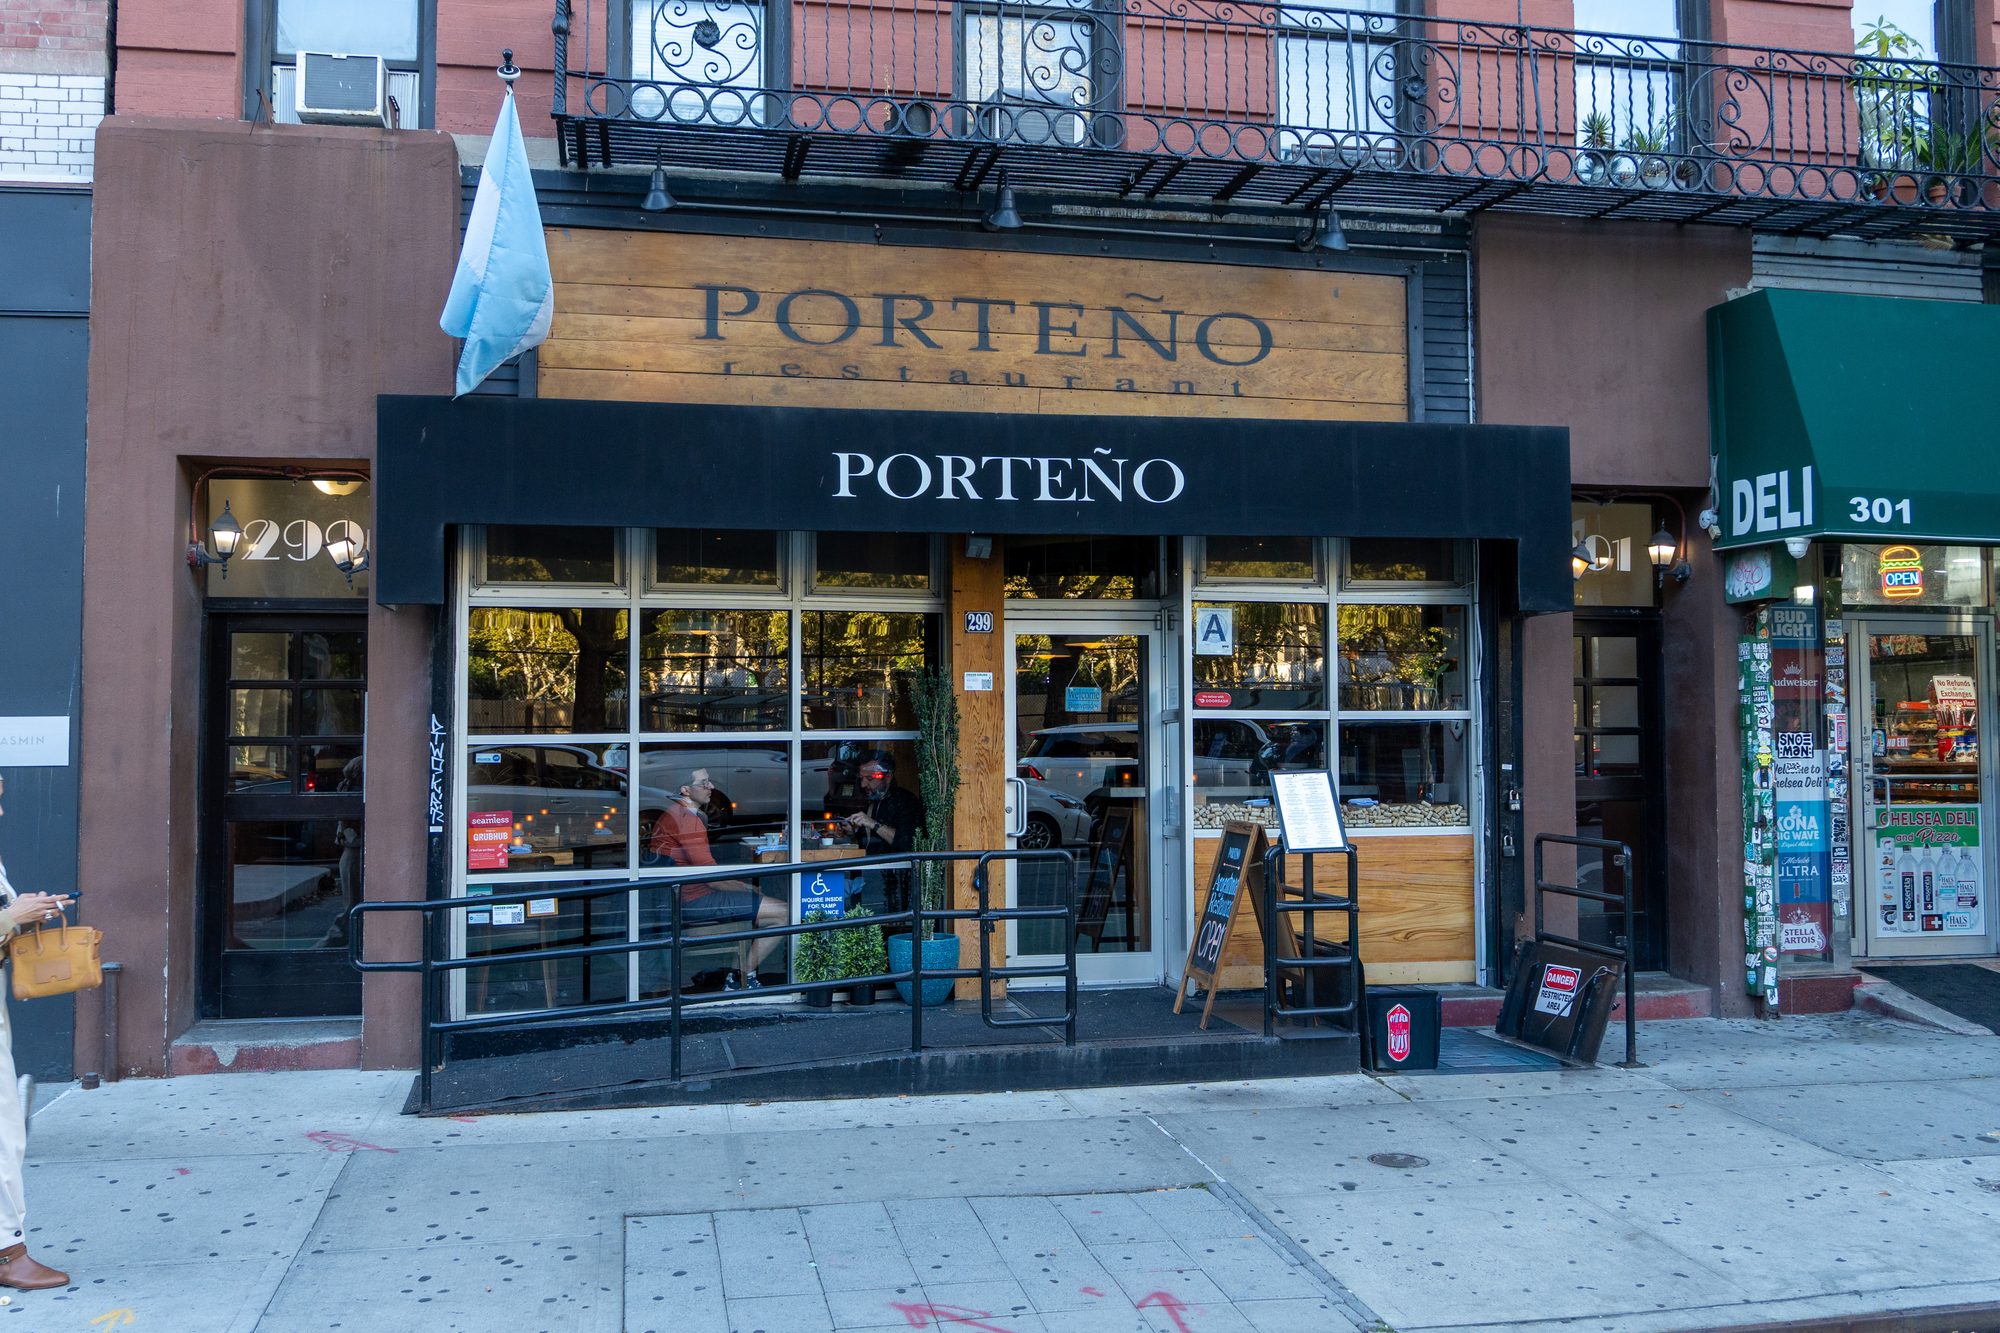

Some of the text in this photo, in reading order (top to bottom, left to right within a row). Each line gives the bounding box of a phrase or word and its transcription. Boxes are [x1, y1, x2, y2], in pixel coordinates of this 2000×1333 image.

[692, 284, 1274, 367] PORTEÑO
[722, 361, 1245, 397] restaurant
[832, 447, 1184, 504] PORTEÑO
[1732, 465, 1813, 536] DELI
[1849, 496, 1911, 524] 301
[1582, 534, 1631, 572] 01
[1886, 571, 1919, 587] OPEN
[967, 613, 991, 631] 299
[1774, 610, 1807, 623] BUD
[1202, 614, 1227, 642] A
[1771, 623, 1814, 637] LIGHT
[1773, 677, 1818, 687] udweiser
[1068, 689, 1100, 700] Welcome
[1940, 690, 1973, 698] Exchanges
[1809, 766, 1820, 774] to
[1805, 777, 1822, 788] Deli
[471, 817, 509, 825] seamless
[1880, 811, 1975, 825] CHELSEA DELI
[473, 832, 509, 841] GRUBHUB
[1777, 830, 1820, 840] IG WAVE
[1896, 827, 1959, 842] and Pizza
[1903, 877, 1912, 910] essentia
[1784, 928, 1815, 936] STELLA
[1784, 936, 1816, 944] ARTOIS
[1546, 972, 1575, 987] DANGER
[1541, 990, 1572, 1002] RESTRICTED
[1546, 1000, 1560, 1012] AREA
